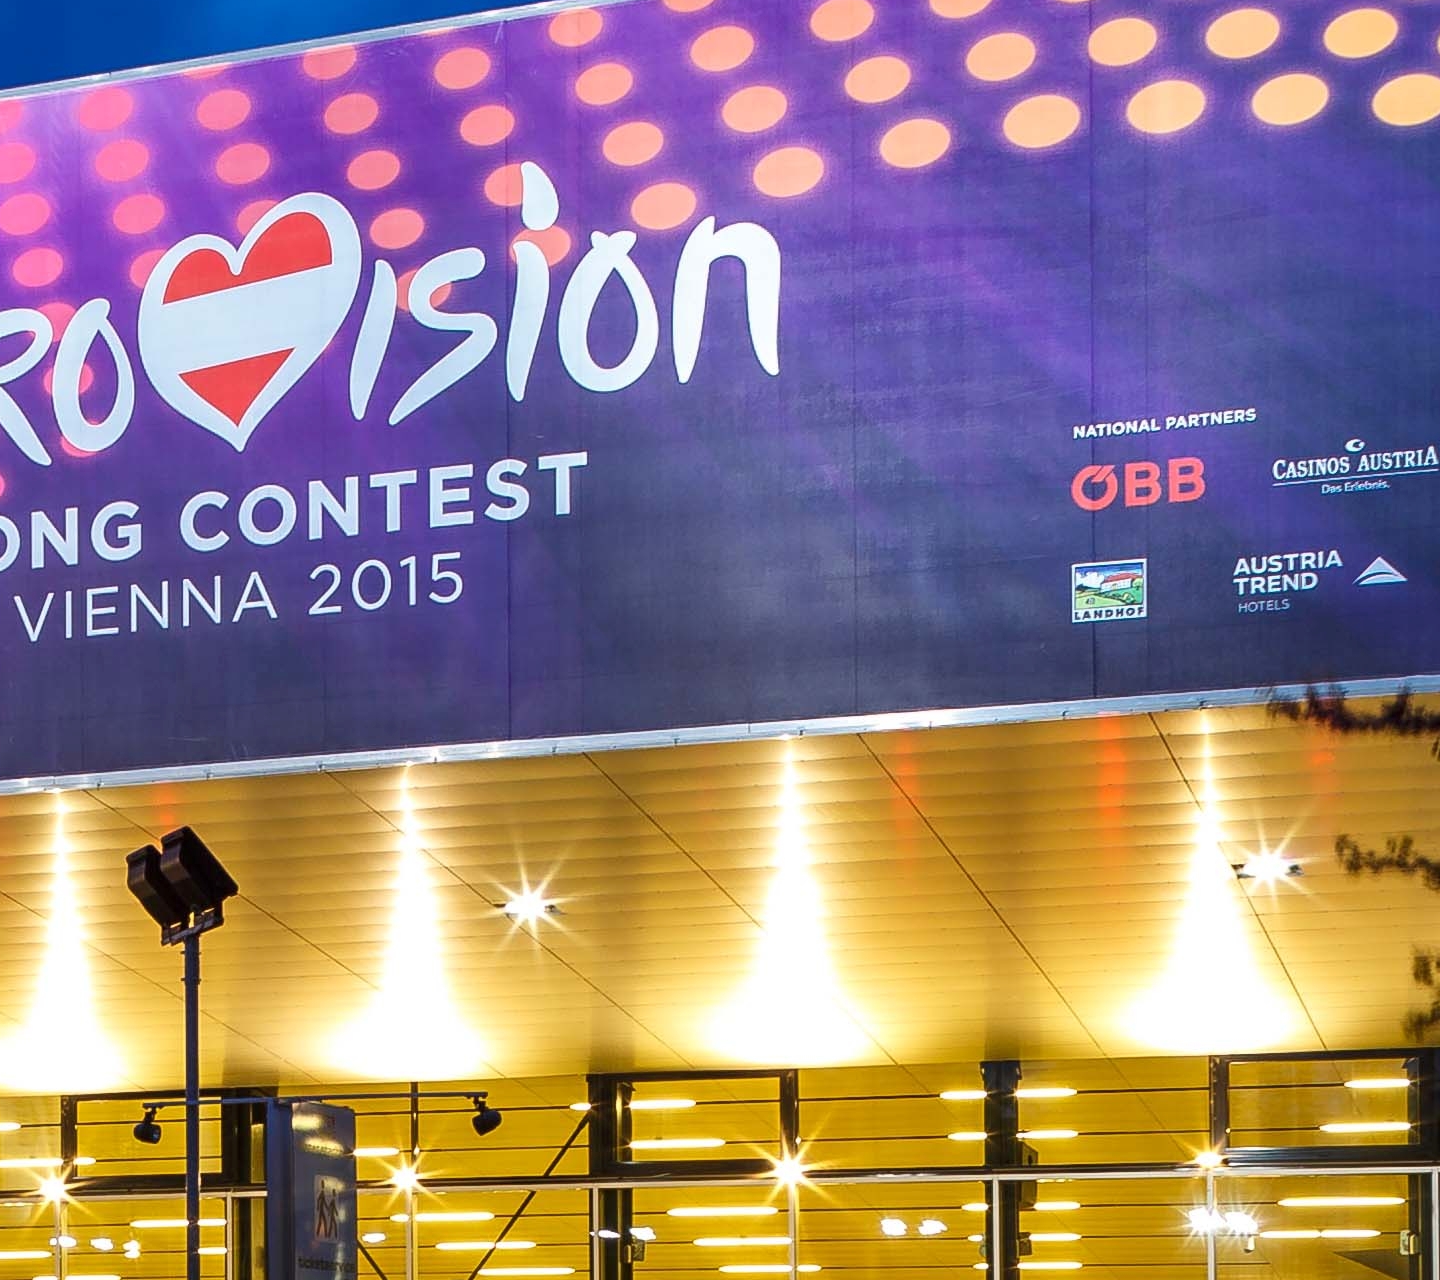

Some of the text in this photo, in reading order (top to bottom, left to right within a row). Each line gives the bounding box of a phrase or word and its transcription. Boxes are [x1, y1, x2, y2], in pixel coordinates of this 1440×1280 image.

[1073, 408, 1257, 440] NATIONAL PARTNERS
[1272, 446, 1439, 481] CASINOS AUSTRIA
[1070, 456, 1206, 512] ÖBB
[1321, 483, 1342, 495] Das
[179, 451, 588, 548] CONTEST
[1232, 550, 1343, 576] AUSTRIA
[14, 551, 464, 644] VIENNA 2015
[1233, 573, 1319, 596] TREND
[1074, 606, 1145, 621] LANDHOF
[1238, 599, 1290, 613] HOTELS
